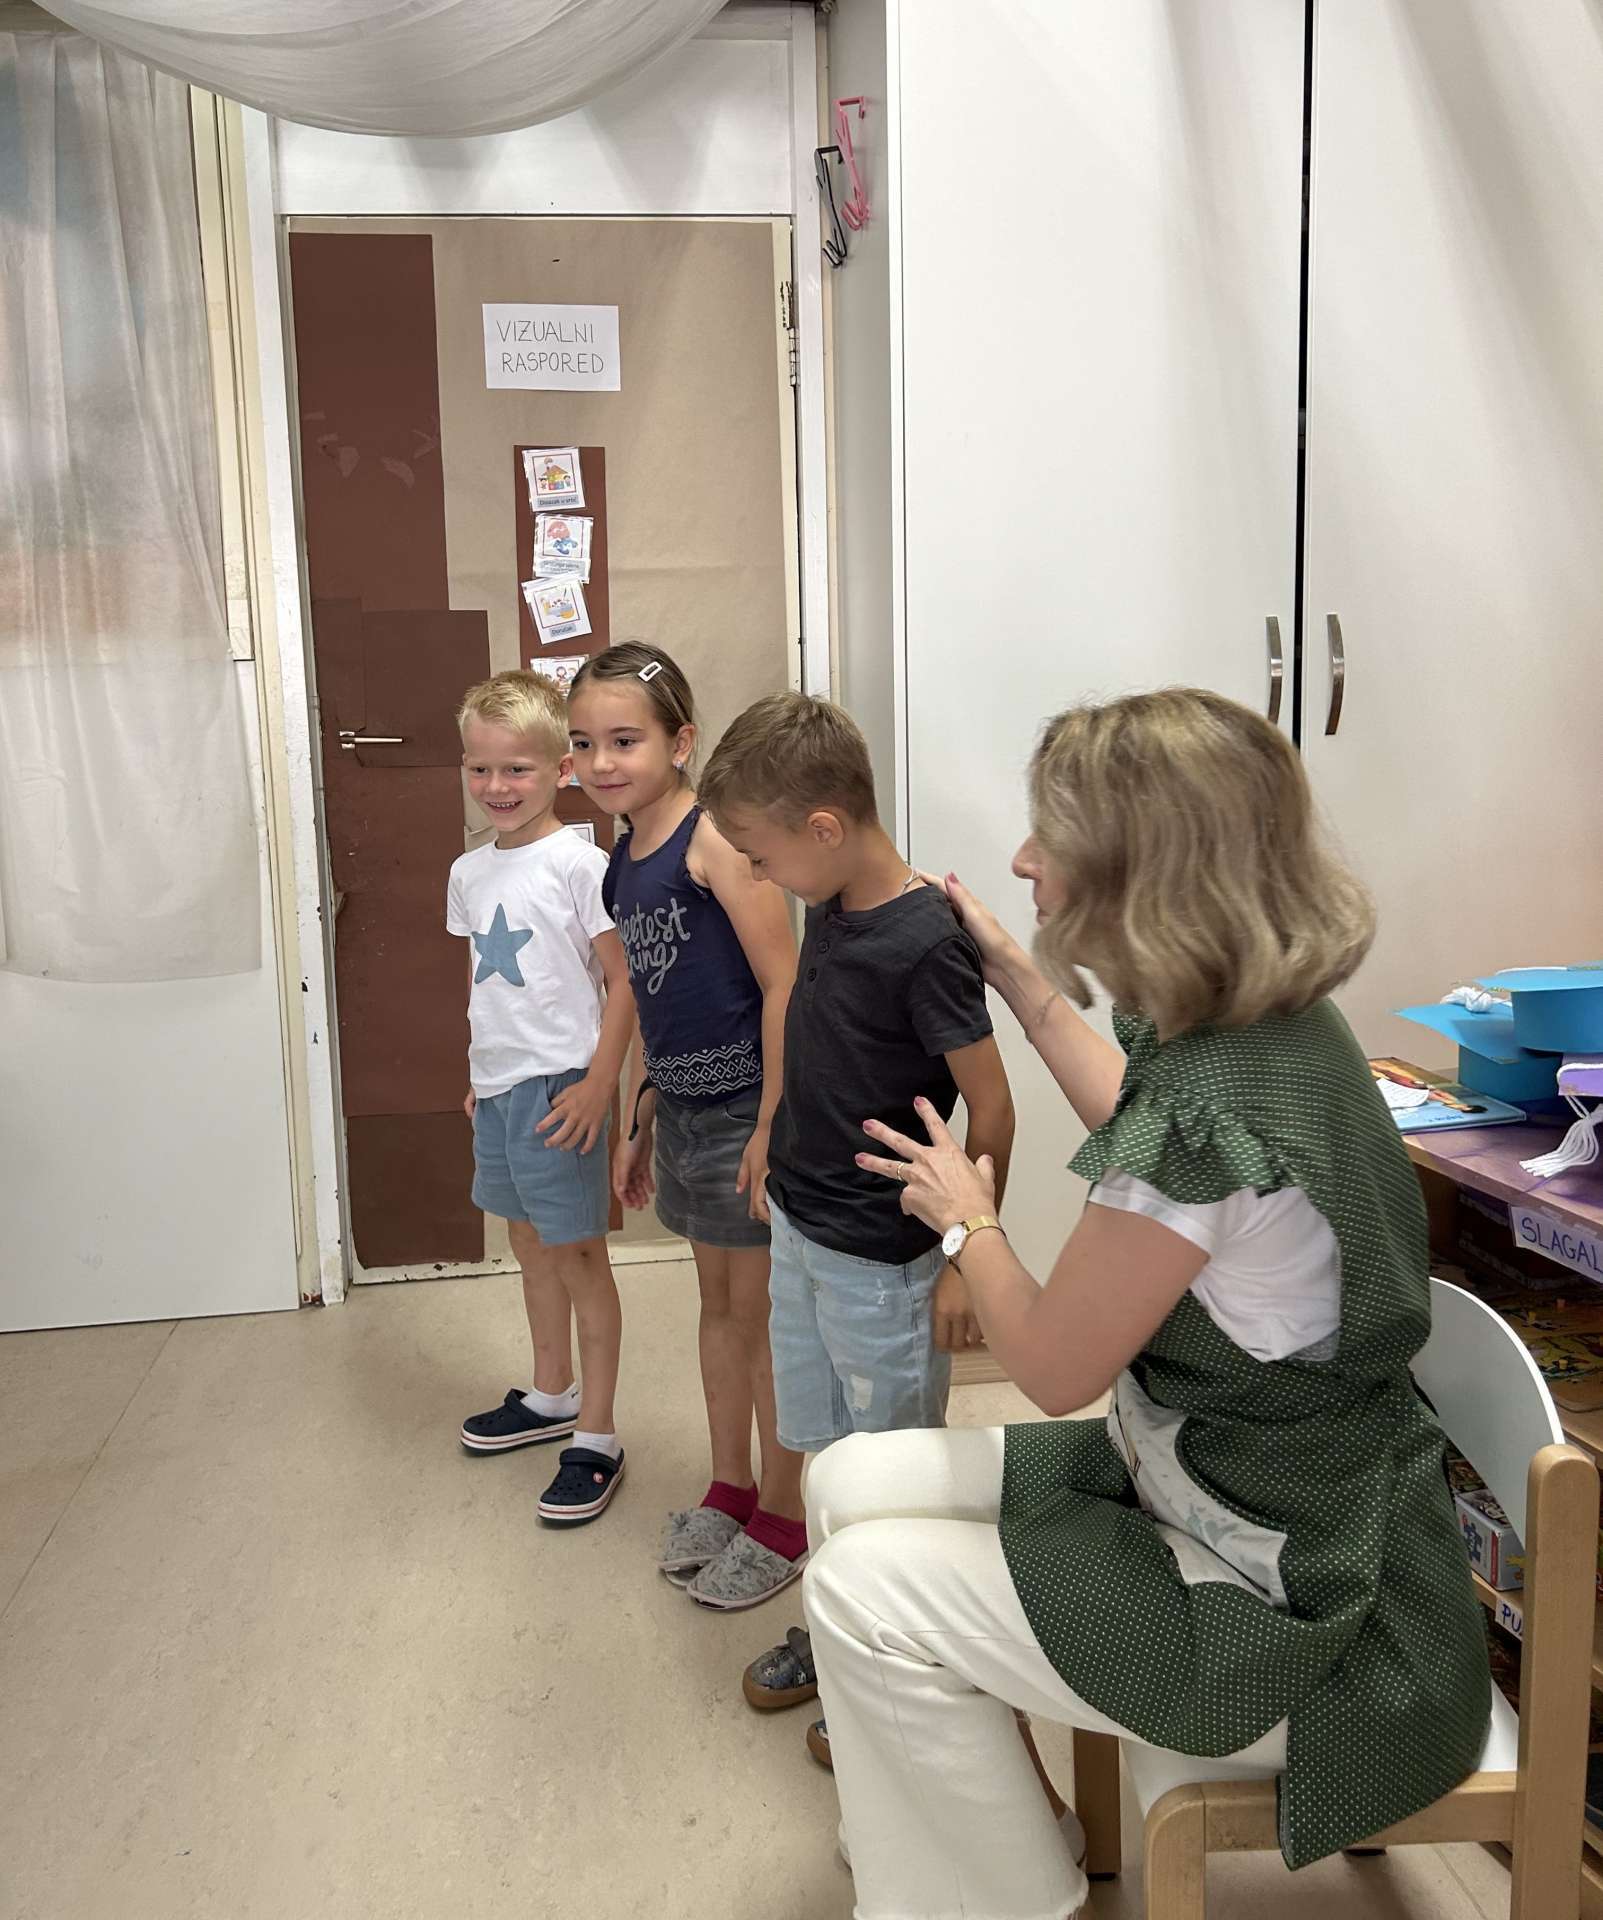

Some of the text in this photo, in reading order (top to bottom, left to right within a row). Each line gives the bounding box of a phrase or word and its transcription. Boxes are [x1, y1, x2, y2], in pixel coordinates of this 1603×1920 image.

[496, 320, 594, 343] VIZUALNI
[502, 352, 604, 373] RASPORED
[1502, 1603, 1523, 1635] PU
